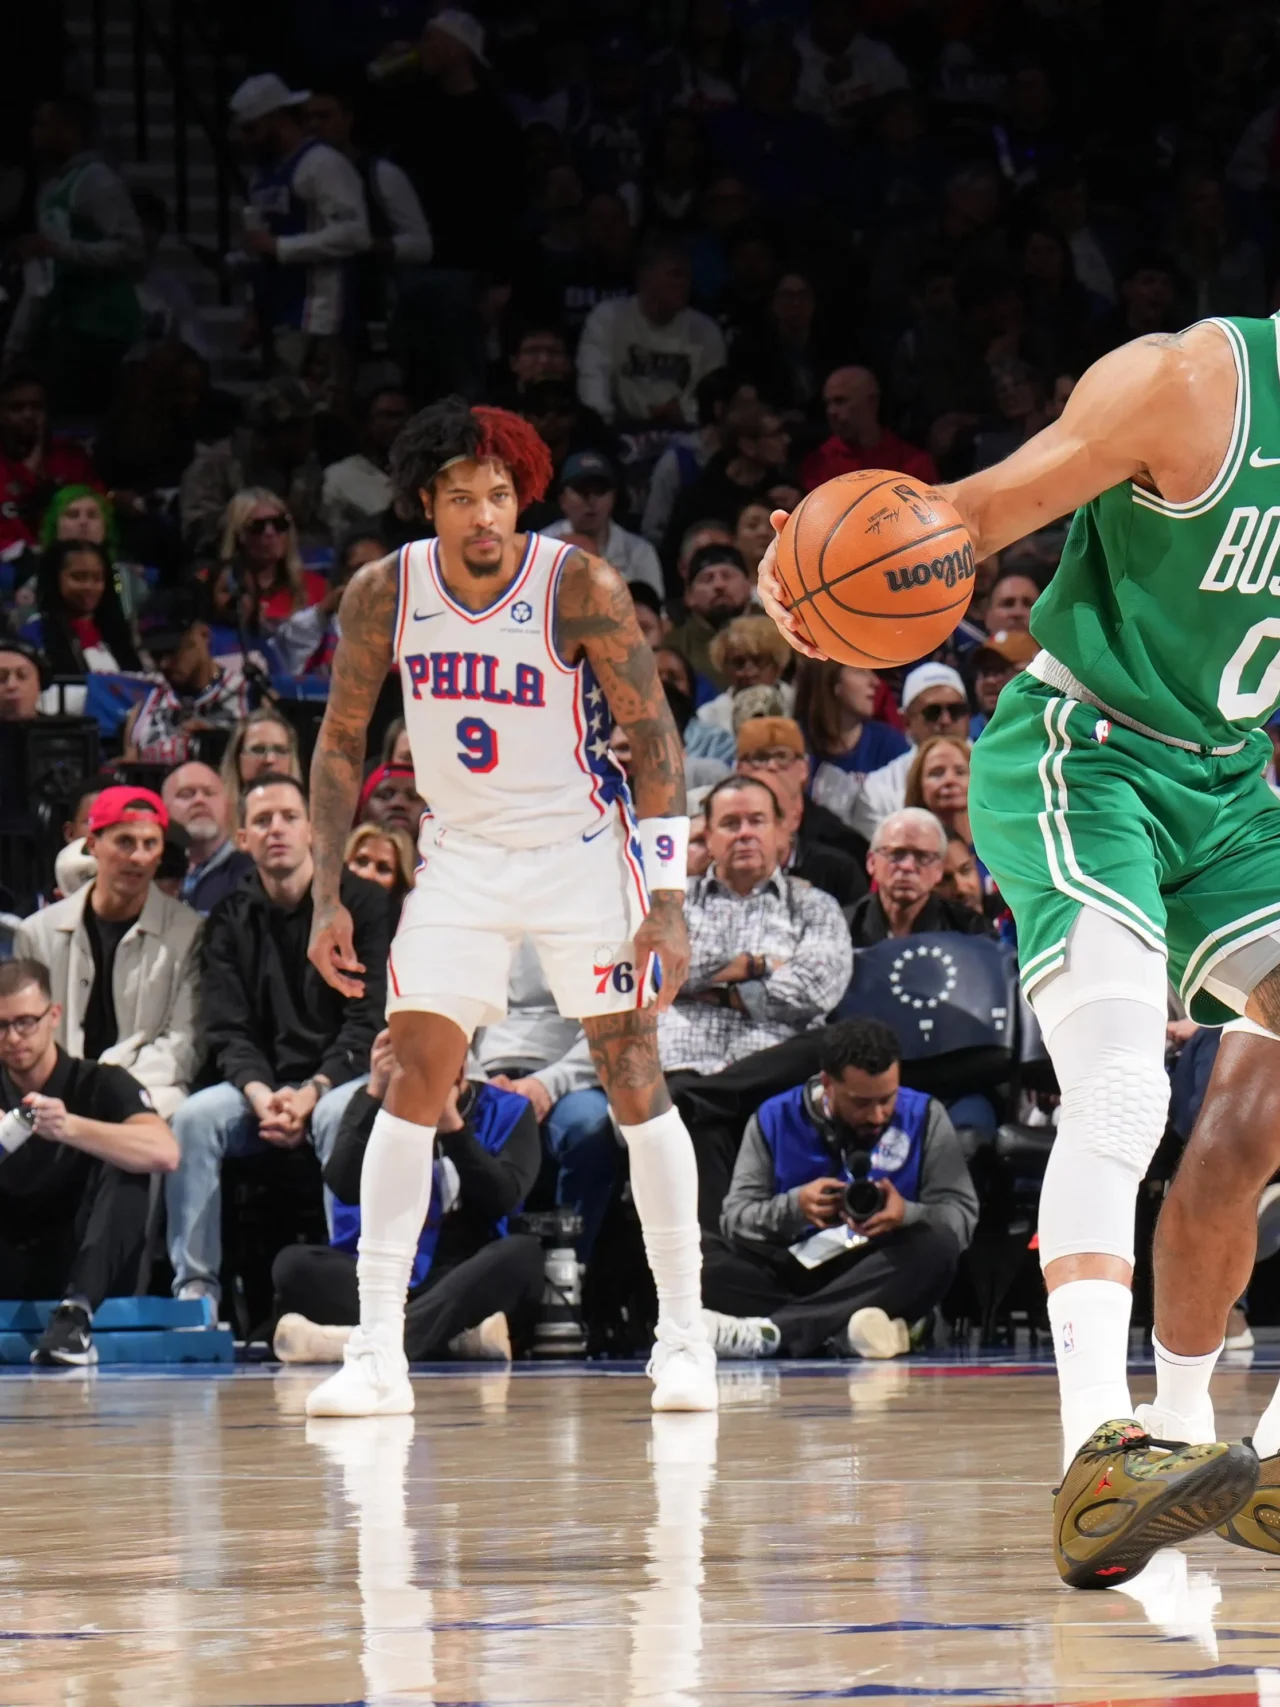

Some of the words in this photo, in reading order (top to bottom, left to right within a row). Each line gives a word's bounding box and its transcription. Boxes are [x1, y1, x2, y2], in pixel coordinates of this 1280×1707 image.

[404, 652, 546, 708] PHILA
[456, 717, 499, 773] 9
[655, 834, 675, 860] 9
[593, 961, 634, 995] 76
